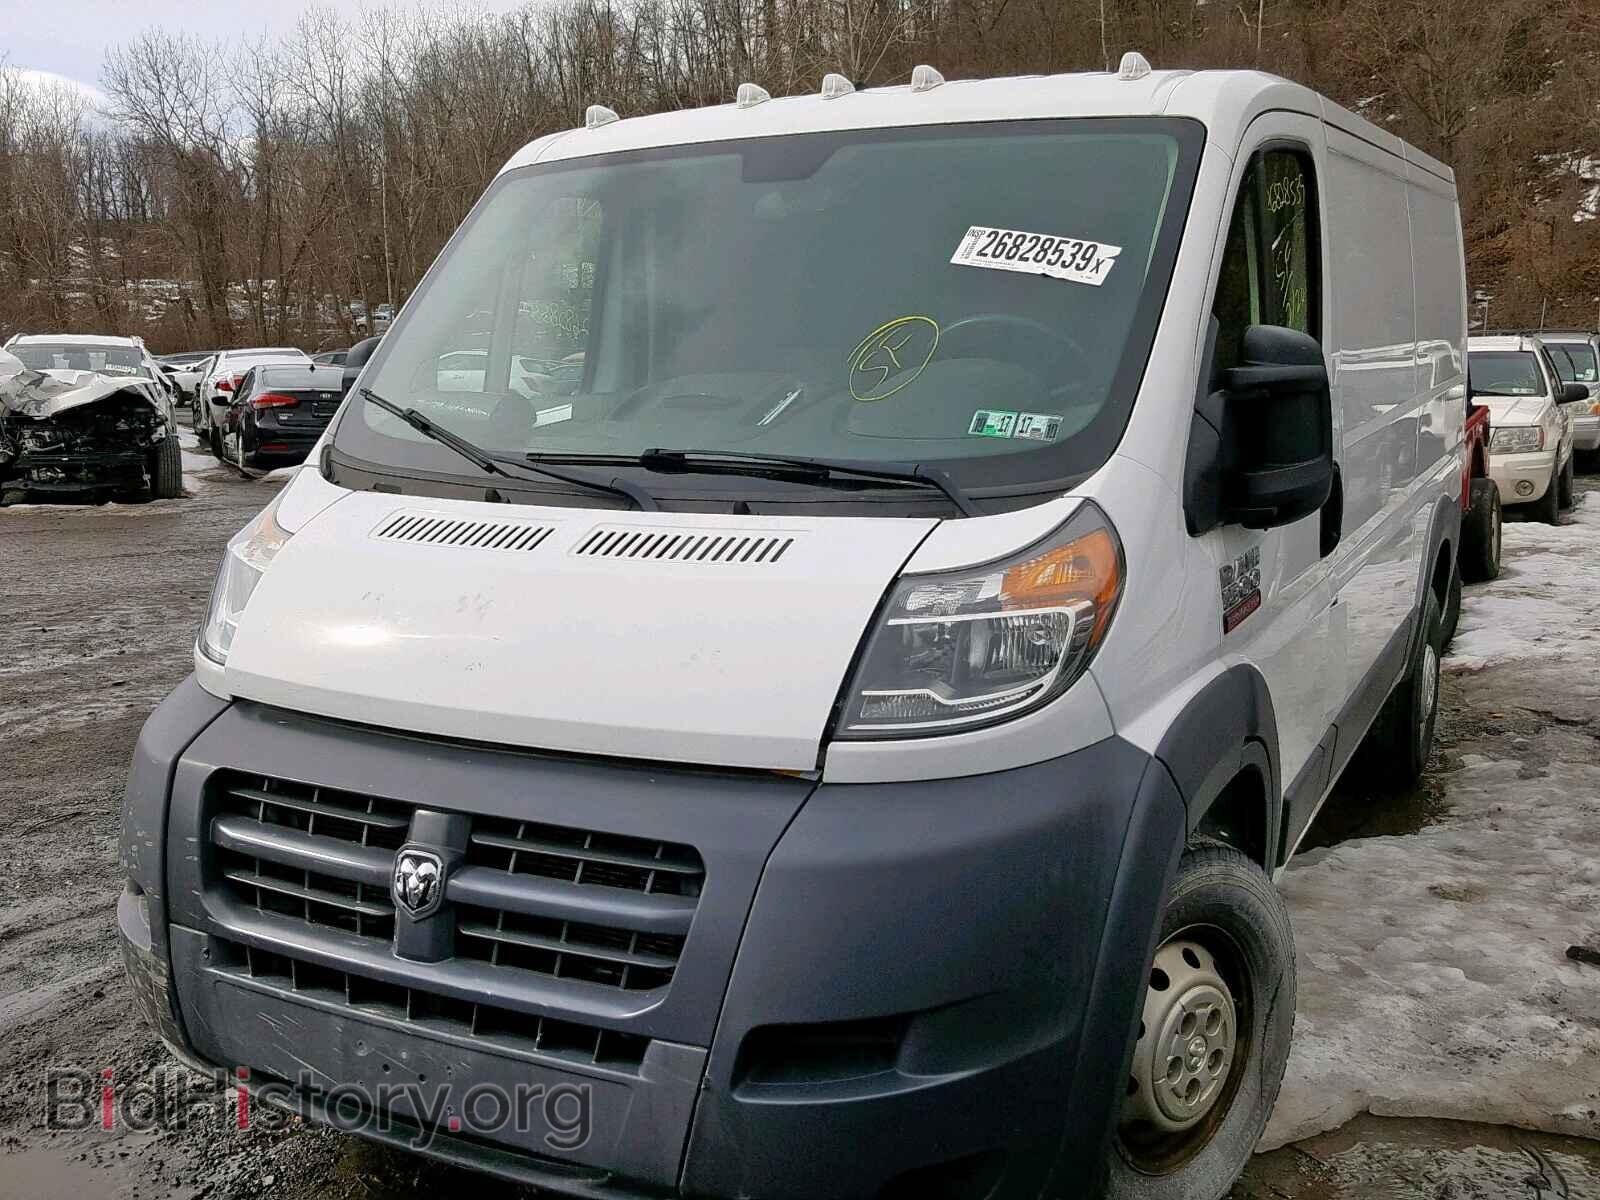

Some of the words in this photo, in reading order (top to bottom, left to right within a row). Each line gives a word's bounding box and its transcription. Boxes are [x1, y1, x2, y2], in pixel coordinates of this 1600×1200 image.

[976, 230, 1098, 271] 26828539
[997, 415, 1013, 432] 17
[1018, 416, 1033, 433] 17
